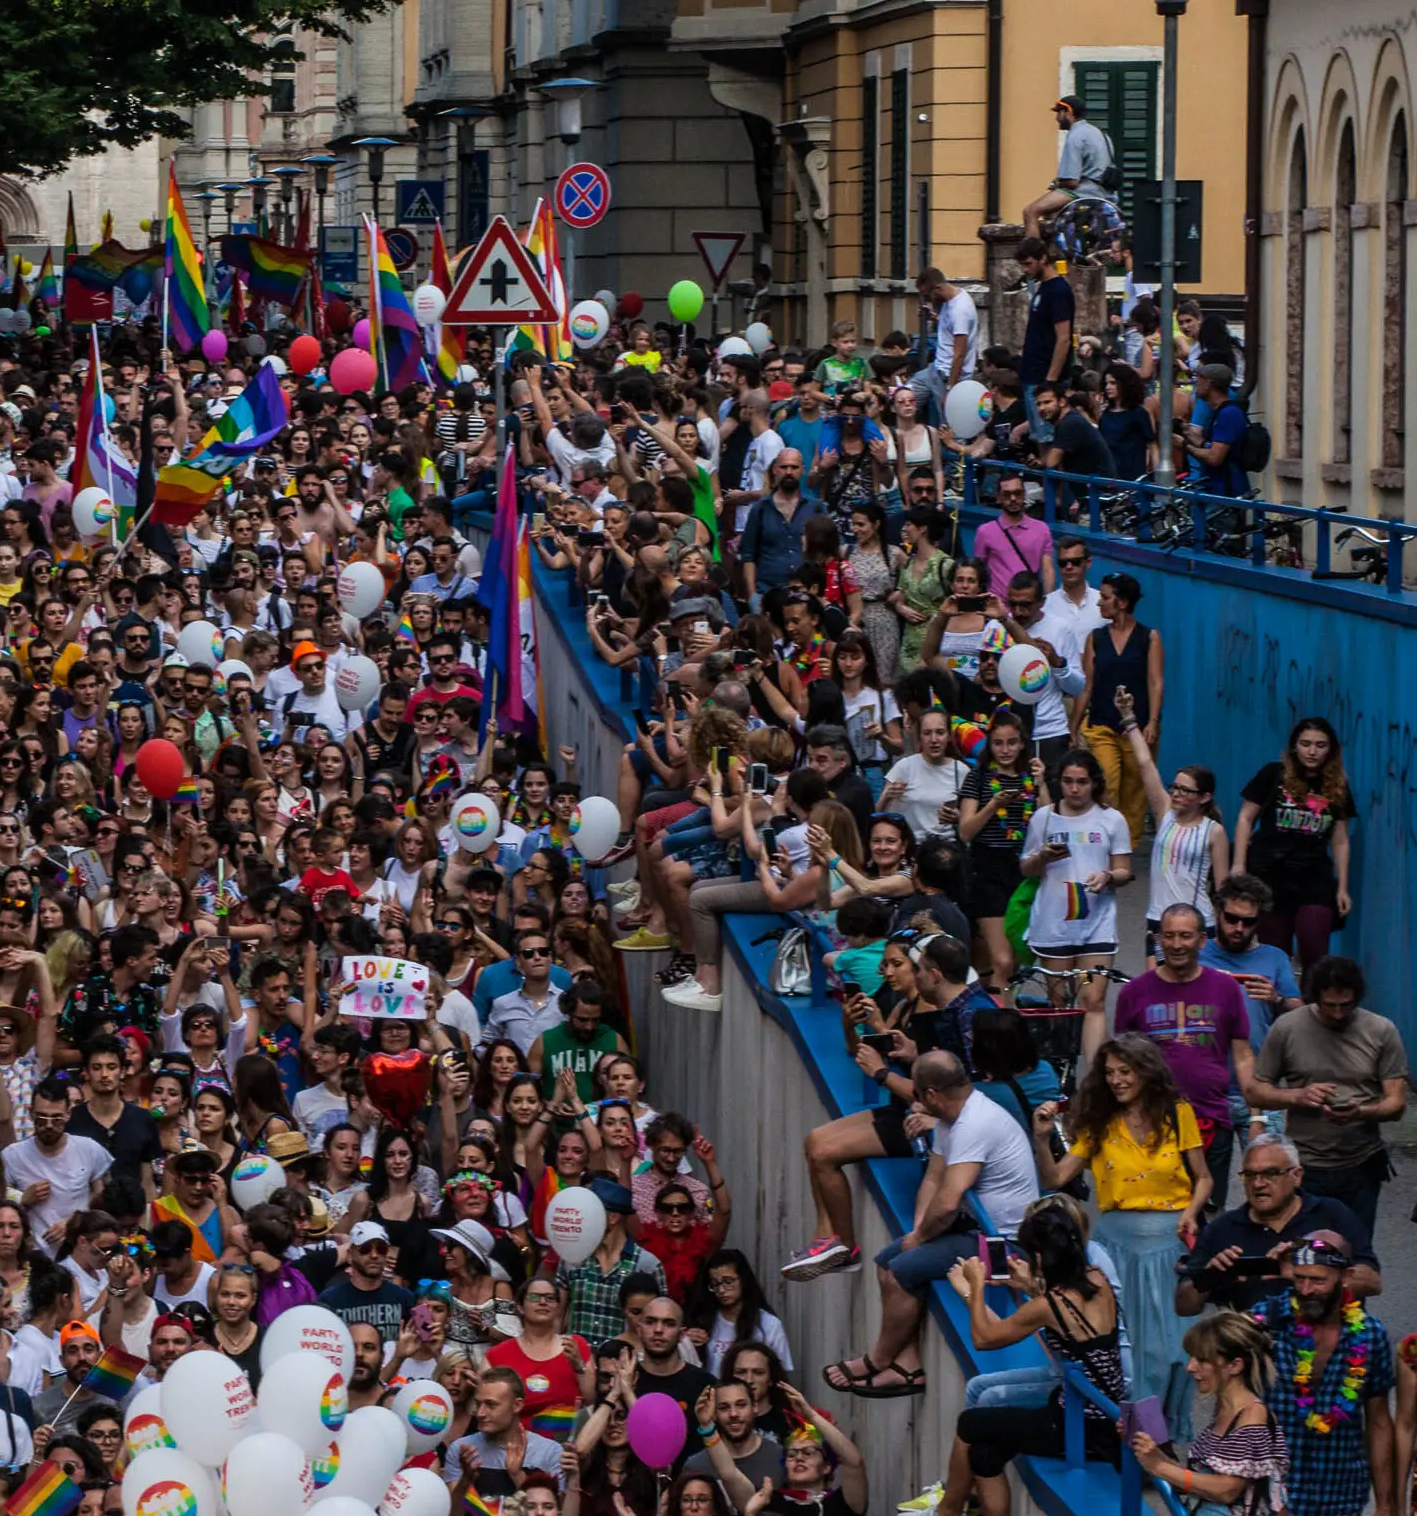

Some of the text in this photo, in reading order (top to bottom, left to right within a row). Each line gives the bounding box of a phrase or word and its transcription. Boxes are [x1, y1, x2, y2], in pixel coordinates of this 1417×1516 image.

[353, 960, 407, 981] LOVE
[353, 992, 417, 1016] LOVE
[550, 1048, 604, 1078] MIAM
[554, 1206, 580, 1216] PARTY
[553, 1216, 583, 1225] WORLD
[550, 1223, 582, 1234] TRENTO
[301, 1328, 340, 1341] PARTY
[299, 1340, 343, 1353] WORLD
